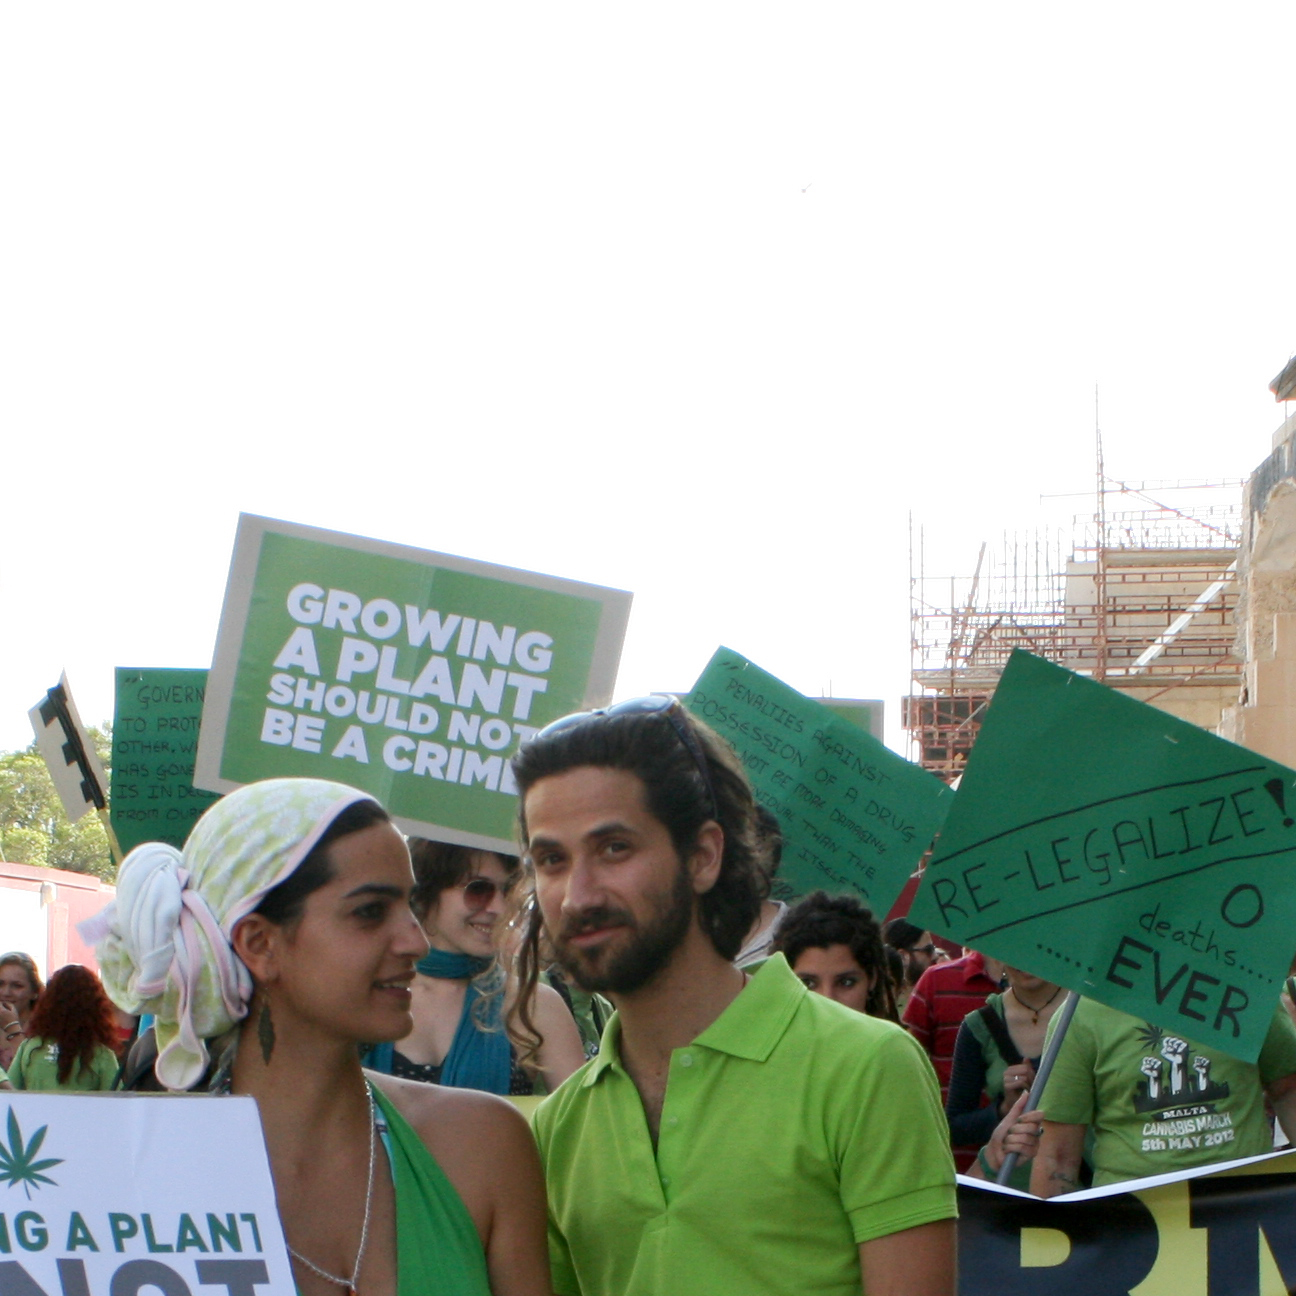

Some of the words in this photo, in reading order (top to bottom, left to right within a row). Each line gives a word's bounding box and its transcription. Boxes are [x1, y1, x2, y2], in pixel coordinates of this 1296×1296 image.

[287, 583, 554, 673] GROWING
[273, 626, 320, 676] A
[336, 636, 548, 720] PLANT
[266, 673, 439, 734] SHOULD
[122, 717, 147, 732] TO
[157, 716, 202, 732] PROT
[261, 708, 326, 753] BE
[332, 726, 369, 764] A
[117, 763, 150, 778] HAS
[741, 750, 769, 774] NOT
[812, 729, 892, 785] AGAINST
[116, 784, 139, 799] IS
[147, 785, 172, 799] IN
[814, 767, 838, 786] OF
[845, 787, 859, 803] A
[864, 800, 917, 844] DRUG
[847, 850, 877, 881] THE
[932, 777, 1296, 929] RE-LEGALIZE!
[1142, 1119, 1196, 1136] CANNABIS
[1196, 1111, 1233, 1133] MARCH
[1162, 1105, 1208, 1119] MALTA
[1141, 1138, 1166, 1151] 5th
[1169, 1135, 1202, 1150] MAY
[1204, 1129, 1235, 1147] 2012
[66, 1211, 100, 1253] A
